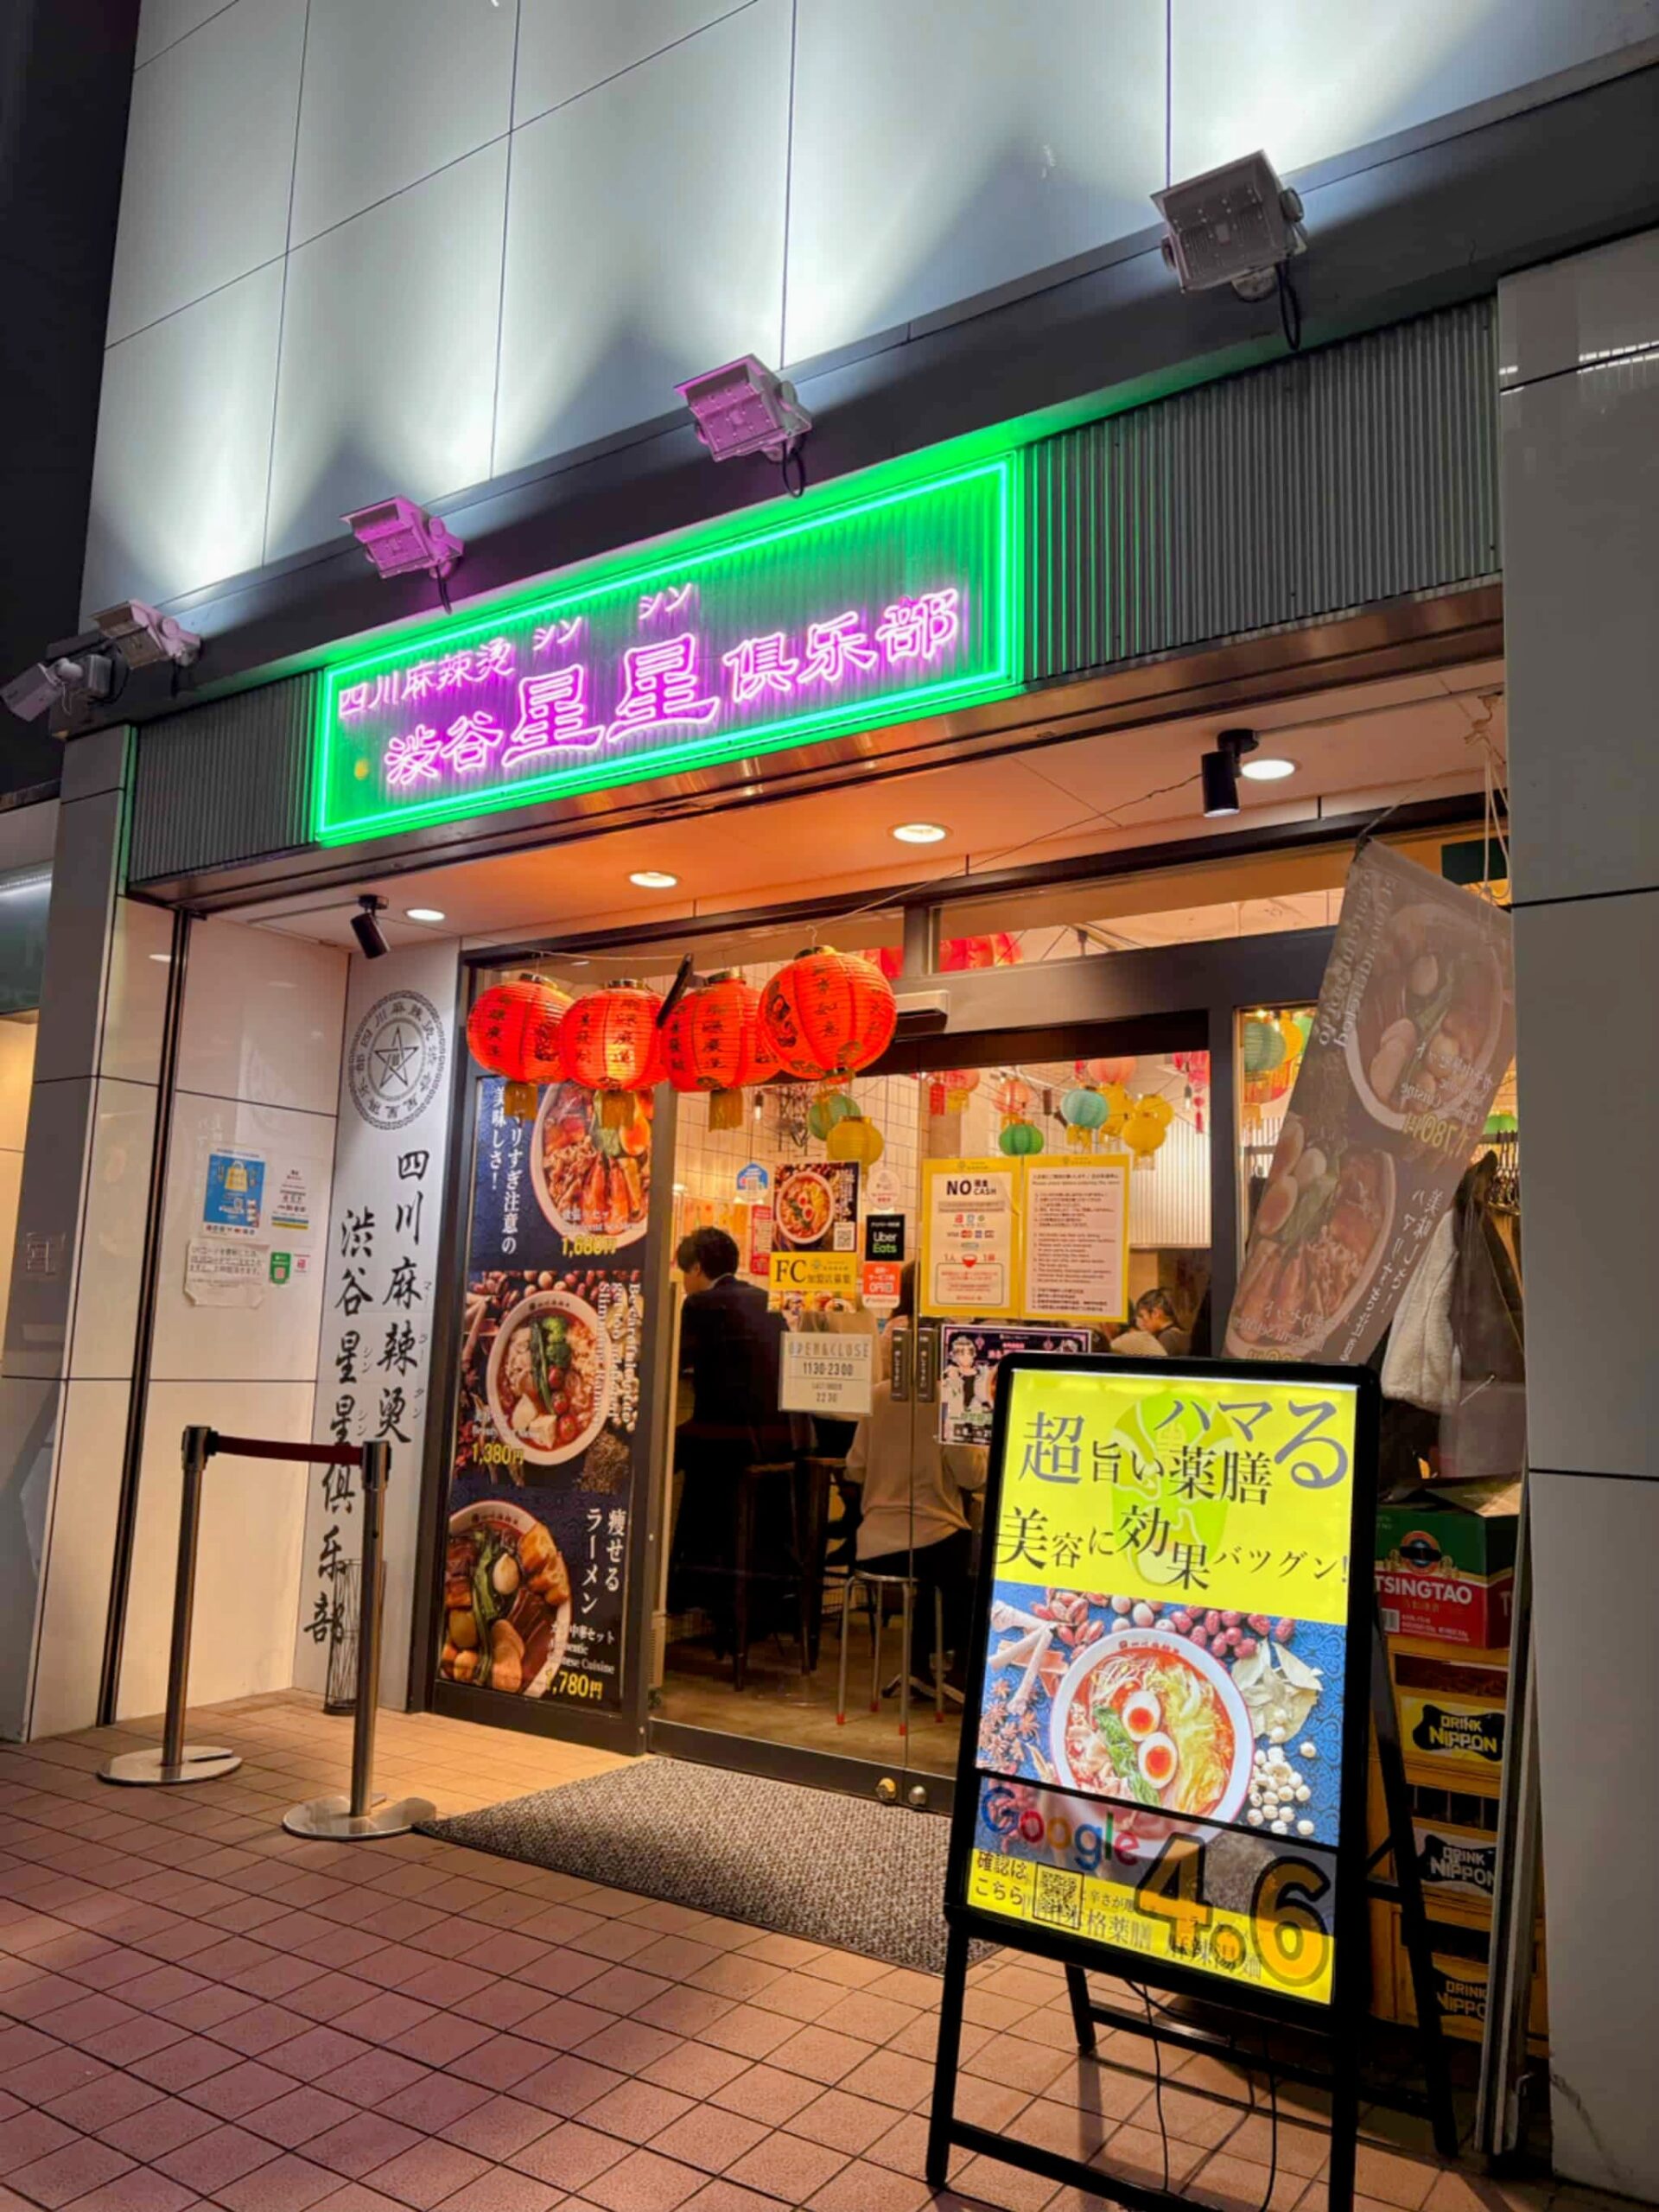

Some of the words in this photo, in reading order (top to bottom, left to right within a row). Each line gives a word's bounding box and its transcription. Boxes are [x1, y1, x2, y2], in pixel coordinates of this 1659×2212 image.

[638, 582, 693, 620] シン
[531, 616, 583, 652] シン
[500, 1090, 524, 1255] リすぎ注意の
[946, 1179, 972, 1196] NO
[872, 1243, 898, 1254] Eats
[873, 1231, 898, 1243] Uber
[775, 1259, 807, 1283] FC
[1017, 1410, 1273, 1506] 超旨い薬膳
[1154, 1398, 1350, 1490] ハマる
[580, 1508, 603, 1614] ラーメン
[604, 1508, 627, 1592] 痩せる
[1374, 1574, 1473, 1605] TSINGTAO
[1440, 1715, 1483, 1732] DRINK
[1429, 1726, 1497, 1753] NIPPON
[981, 1785, 1141, 1872] Google
[976, 1850, 1028, 1881] 確認は
[1443, 1846, 1486, 1866] DRINK
[976, 1877, 1024, 1906] こちら
[1134, 1831, 1332, 1988] 4.6
